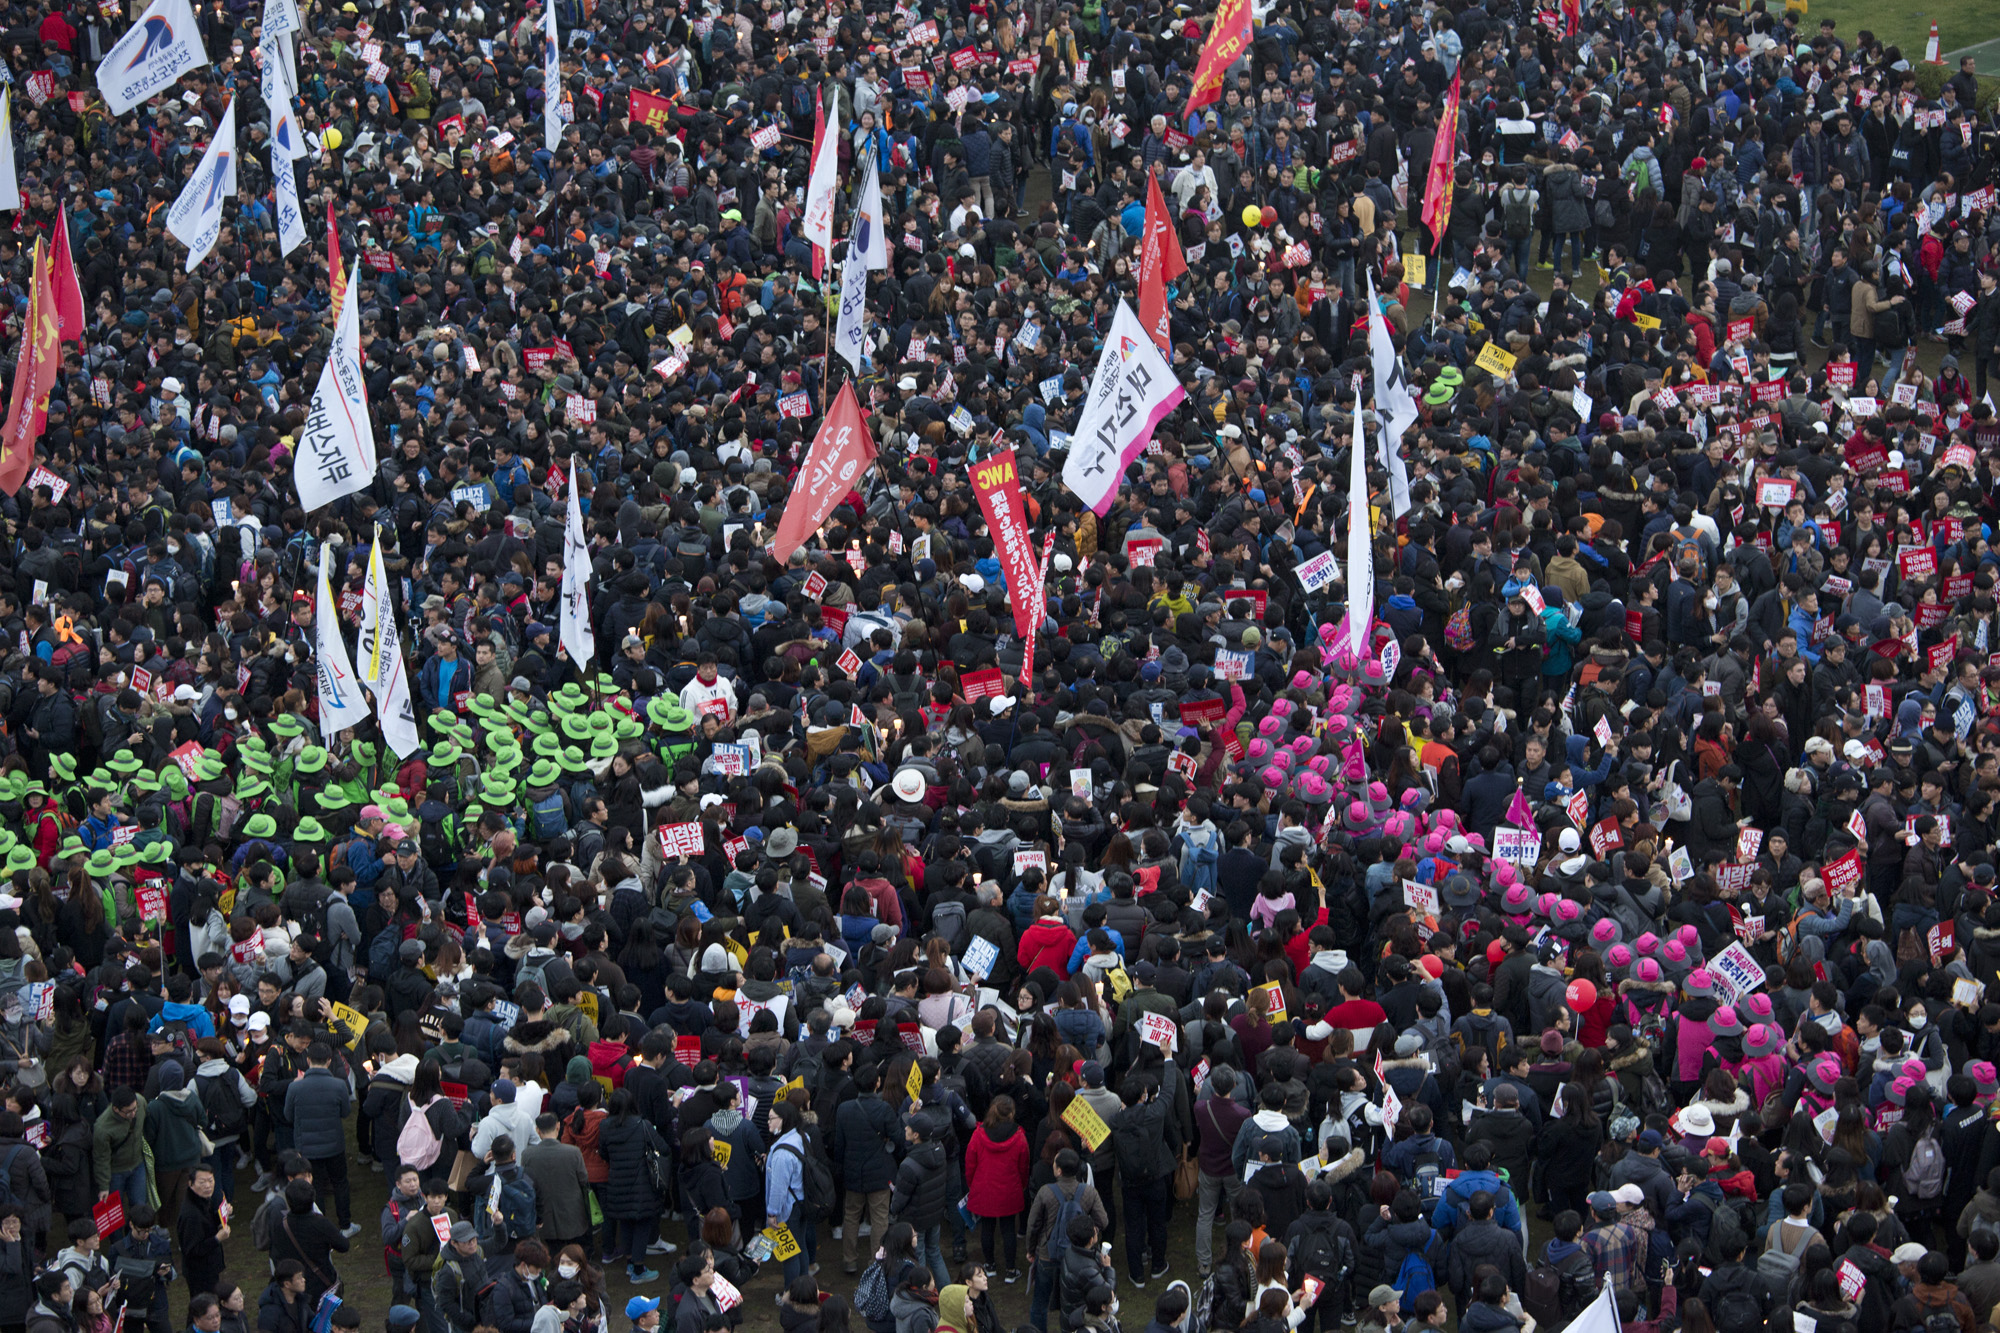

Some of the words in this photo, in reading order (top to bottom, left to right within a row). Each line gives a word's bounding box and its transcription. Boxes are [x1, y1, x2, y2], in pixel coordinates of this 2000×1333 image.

[1892, 149, 1909, 160] BLACK
[526, 352, 551, 361] 박근혜는
[1480, 353, 1512, 376] 성과퇴출제
[1831, 368, 1854, 376] 박근혜는
[1831, 375, 1854, 384] 하야하라
[1693, 384, 1721, 395] 박근혜
[1755, 385, 1781, 396] 박근혜는
[1897, 386, 1915, 395] 박근혜
[782, 397, 809, 410] 박근혜
[1854, 398, 1874, 407] 박근혜
[791, 406, 808, 418] 퇴진
[32, 468, 70, 493] 내려와
[452, 486, 484, 500] 끝내자
[1905, 554, 1933, 565] 박근혜는
[1298, 554, 1332, 581] 교육공무직
[1906, 562, 1934, 574] 하야하라
[1307, 564, 1336, 588] 쟁취!!
[1827, 577, 1851, 588] 박근혜
[1931, 643, 1954, 659] 박근혜는
[1215, 660, 1243, 670] 박근혜
[1383, 645, 1393, 681] 쟁취!!
[1706, 684, 1722, 696] 박근
[715, 753, 741, 764] 박근혜
[725, 763, 741, 774] 퇴진
[660, 822, 703, 844] 내려와
[664, 837, 704, 857] 박근혜
[1499, 845, 1535, 859] 쟁취!!
[1016, 853, 1044, 863] 새누리당
[1717, 864, 1762, 882] 내려와
[1828, 858, 1856, 880] 박근혜는
[1830, 867, 1858, 888] 하야하라
[1407, 879, 1433, 893] 박근혜
[1724, 945, 1764, 983] 교육공무직
[1719, 957, 1752, 991] 쟁취!!
[1146, 1014, 1177, 1034] 노동개악
[1881, 1108, 1903, 1122] 재벌
